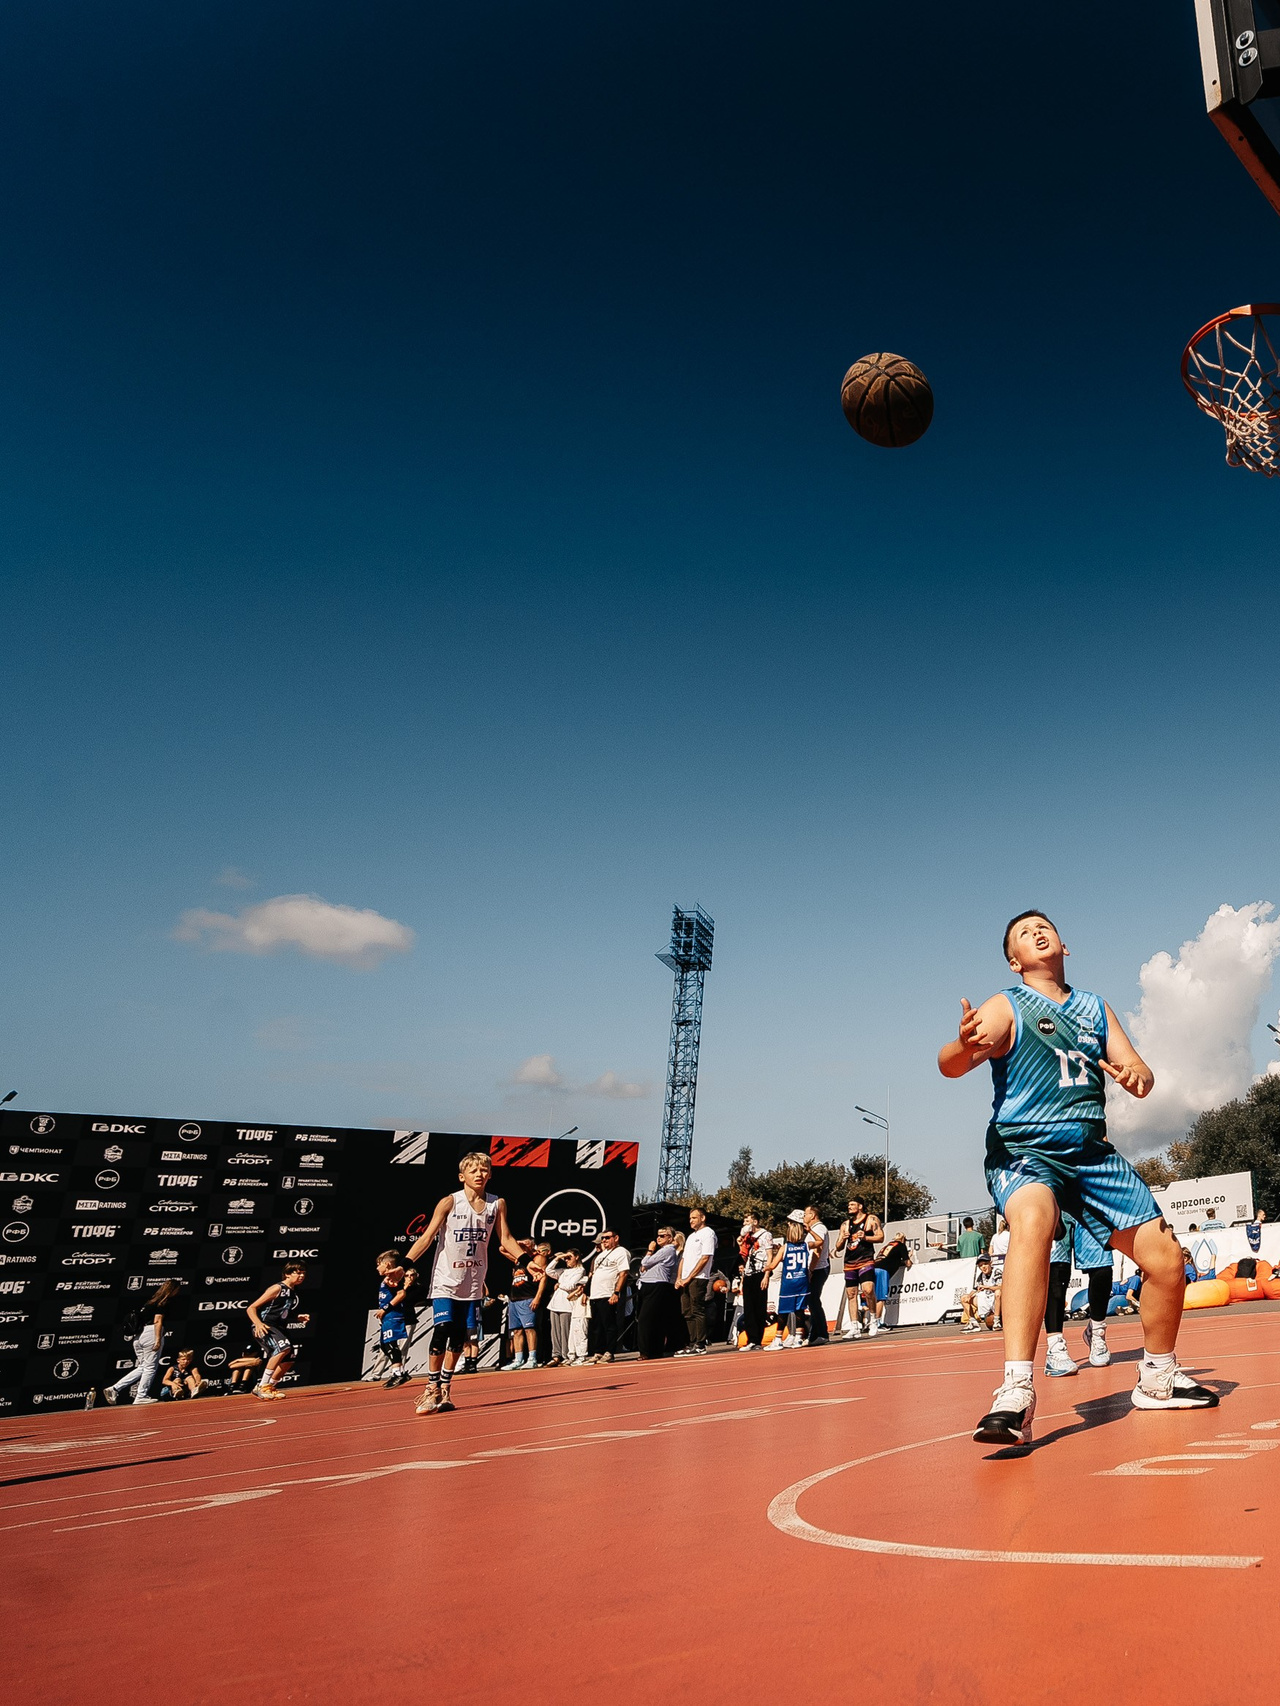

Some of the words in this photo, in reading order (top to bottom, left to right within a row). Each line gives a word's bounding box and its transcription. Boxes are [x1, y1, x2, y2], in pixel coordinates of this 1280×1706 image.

[1054, 1048, 1090, 1088] 17
[110, 1124, 146, 1133] DKC
[20, 1173, 59, 1182] DKC
[1170, 1195, 1226, 1211] appzone.co
[541, 1219, 598, 1238] РФБ
[289, 1249, 318, 1257] DKC
[786, 1253, 807, 1271] 34
[280, 1288, 291, 1298] 24
[215, 1300, 249, 1311] DKC
[382, 1329, 393, 1341] 20
[278, 1338, 292, 1349] 24
[205, 1353, 225, 1361] РФБ
[43, 1391, 88, 1401] ЧЕМПИОНАТ
